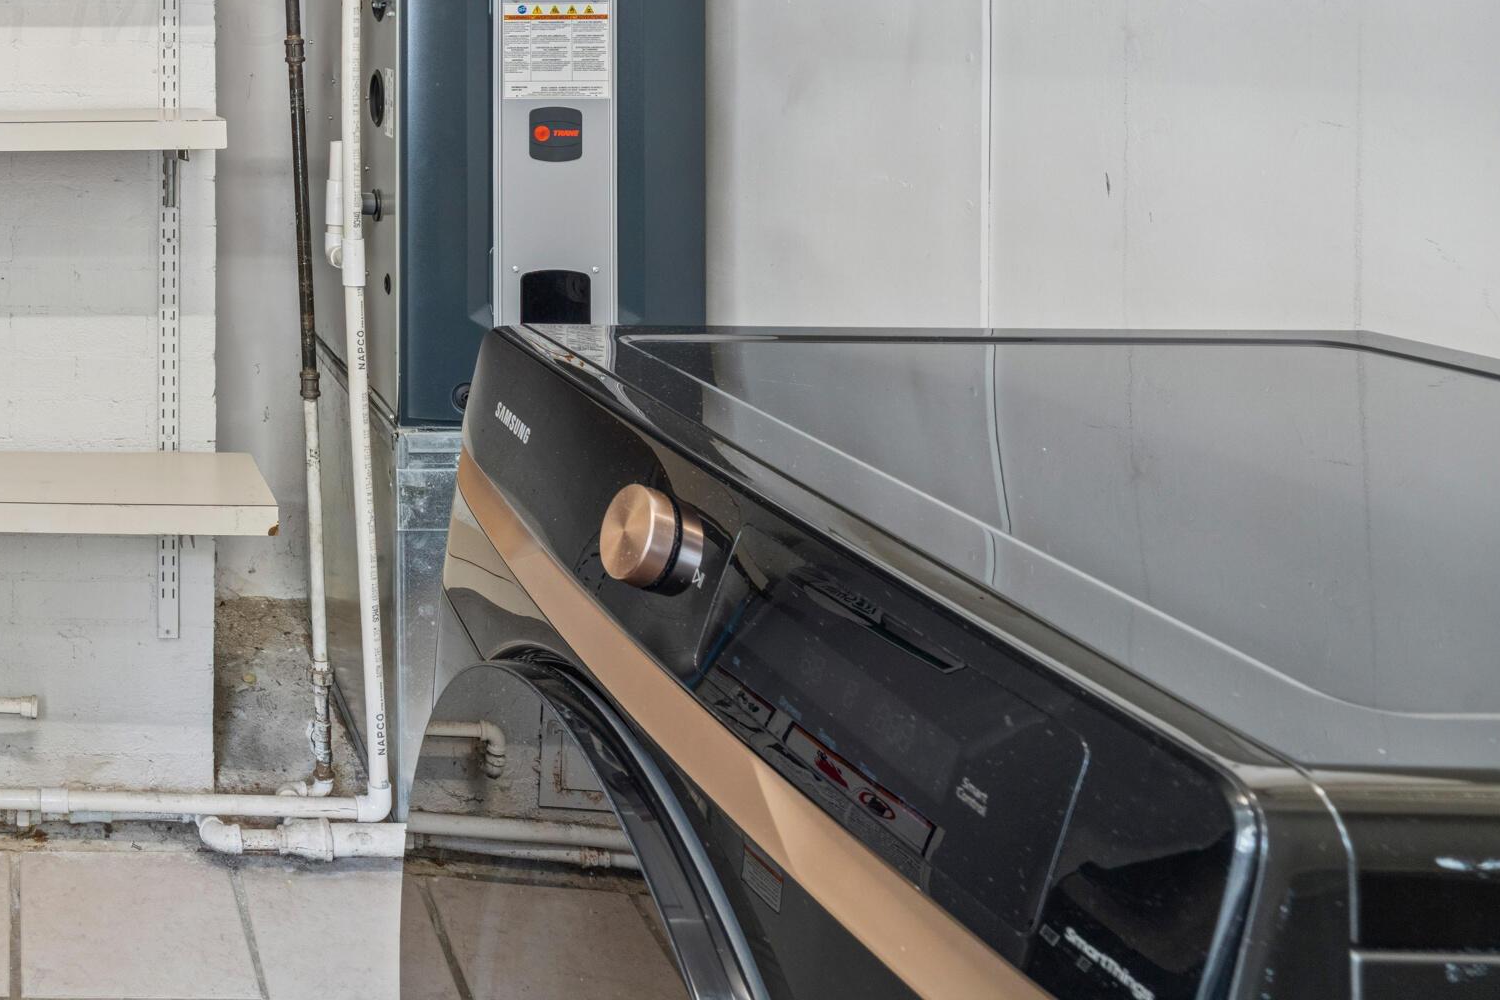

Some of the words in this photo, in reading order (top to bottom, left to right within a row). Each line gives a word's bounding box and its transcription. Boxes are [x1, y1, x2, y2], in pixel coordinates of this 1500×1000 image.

[553, 129, 580, 138] TRANE
[356, 329, 366, 371] NAPCO
[494, 401, 532, 445] SAMSUNG
[375, 712, 386, 756] NAPCO
